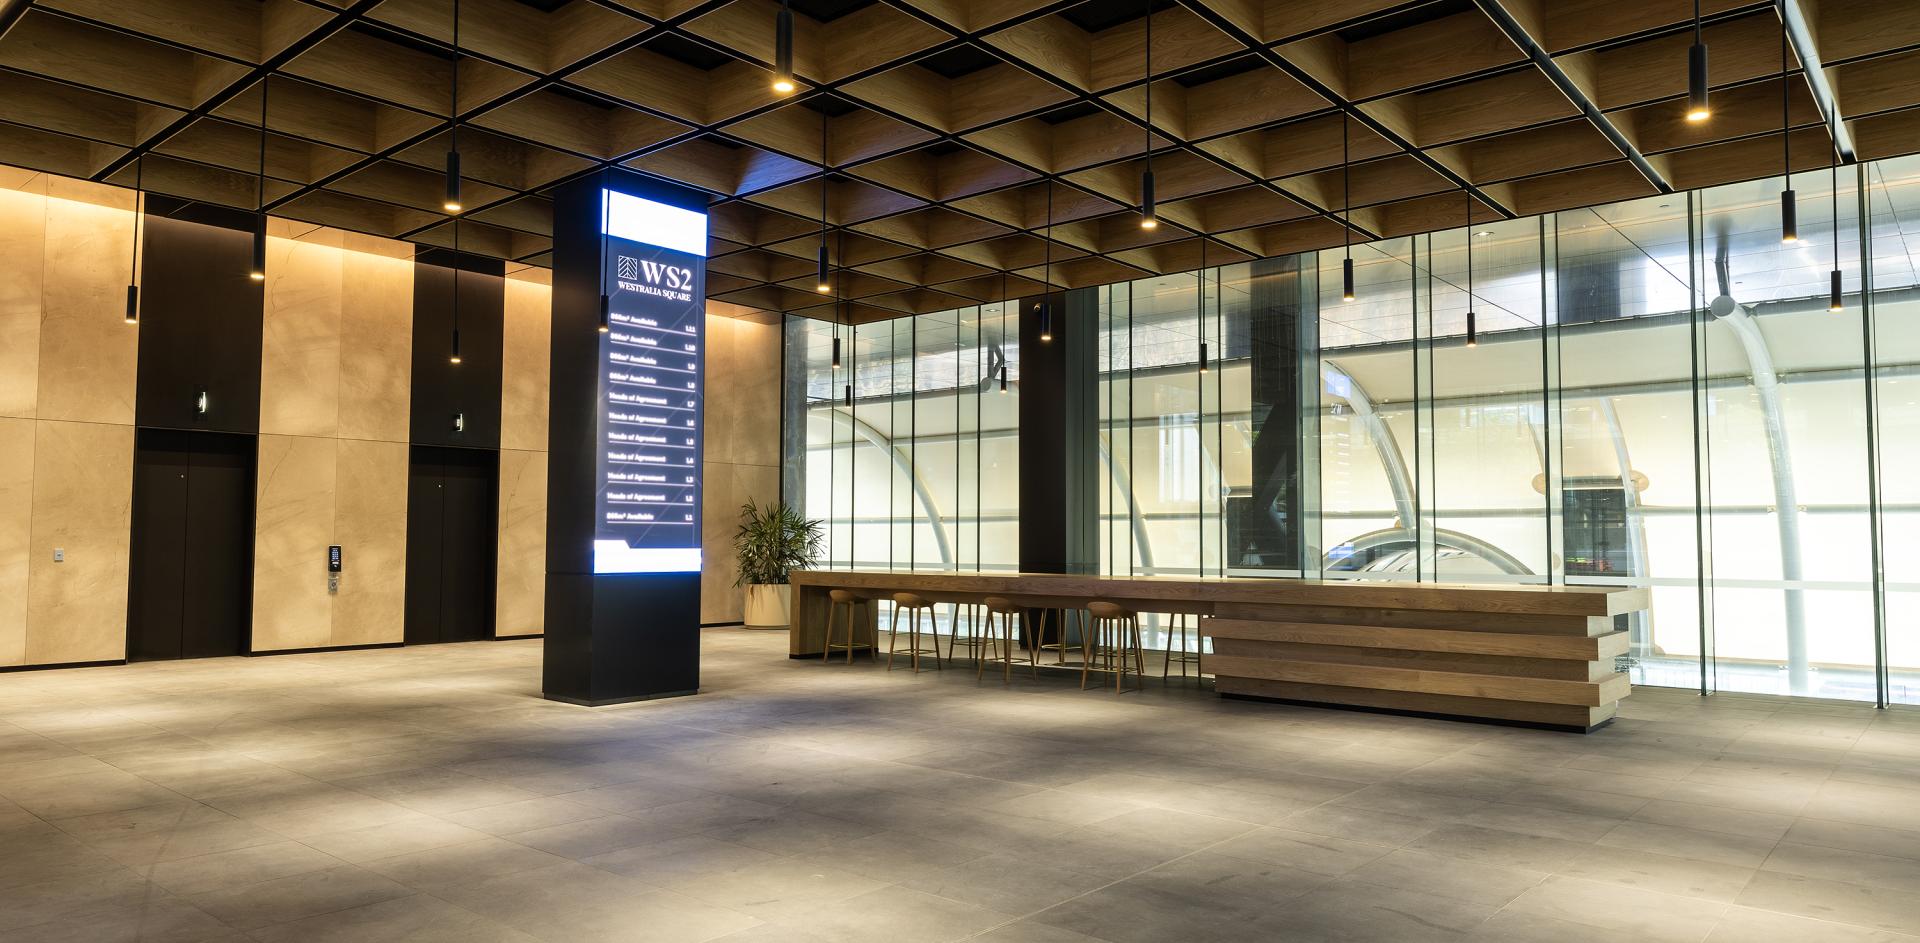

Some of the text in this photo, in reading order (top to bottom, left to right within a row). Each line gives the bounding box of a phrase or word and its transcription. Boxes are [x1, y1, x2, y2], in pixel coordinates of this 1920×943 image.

[640, 260, 692, 291] WS2
[618, 281, 692, 302] WESTRALIA SQUARE
